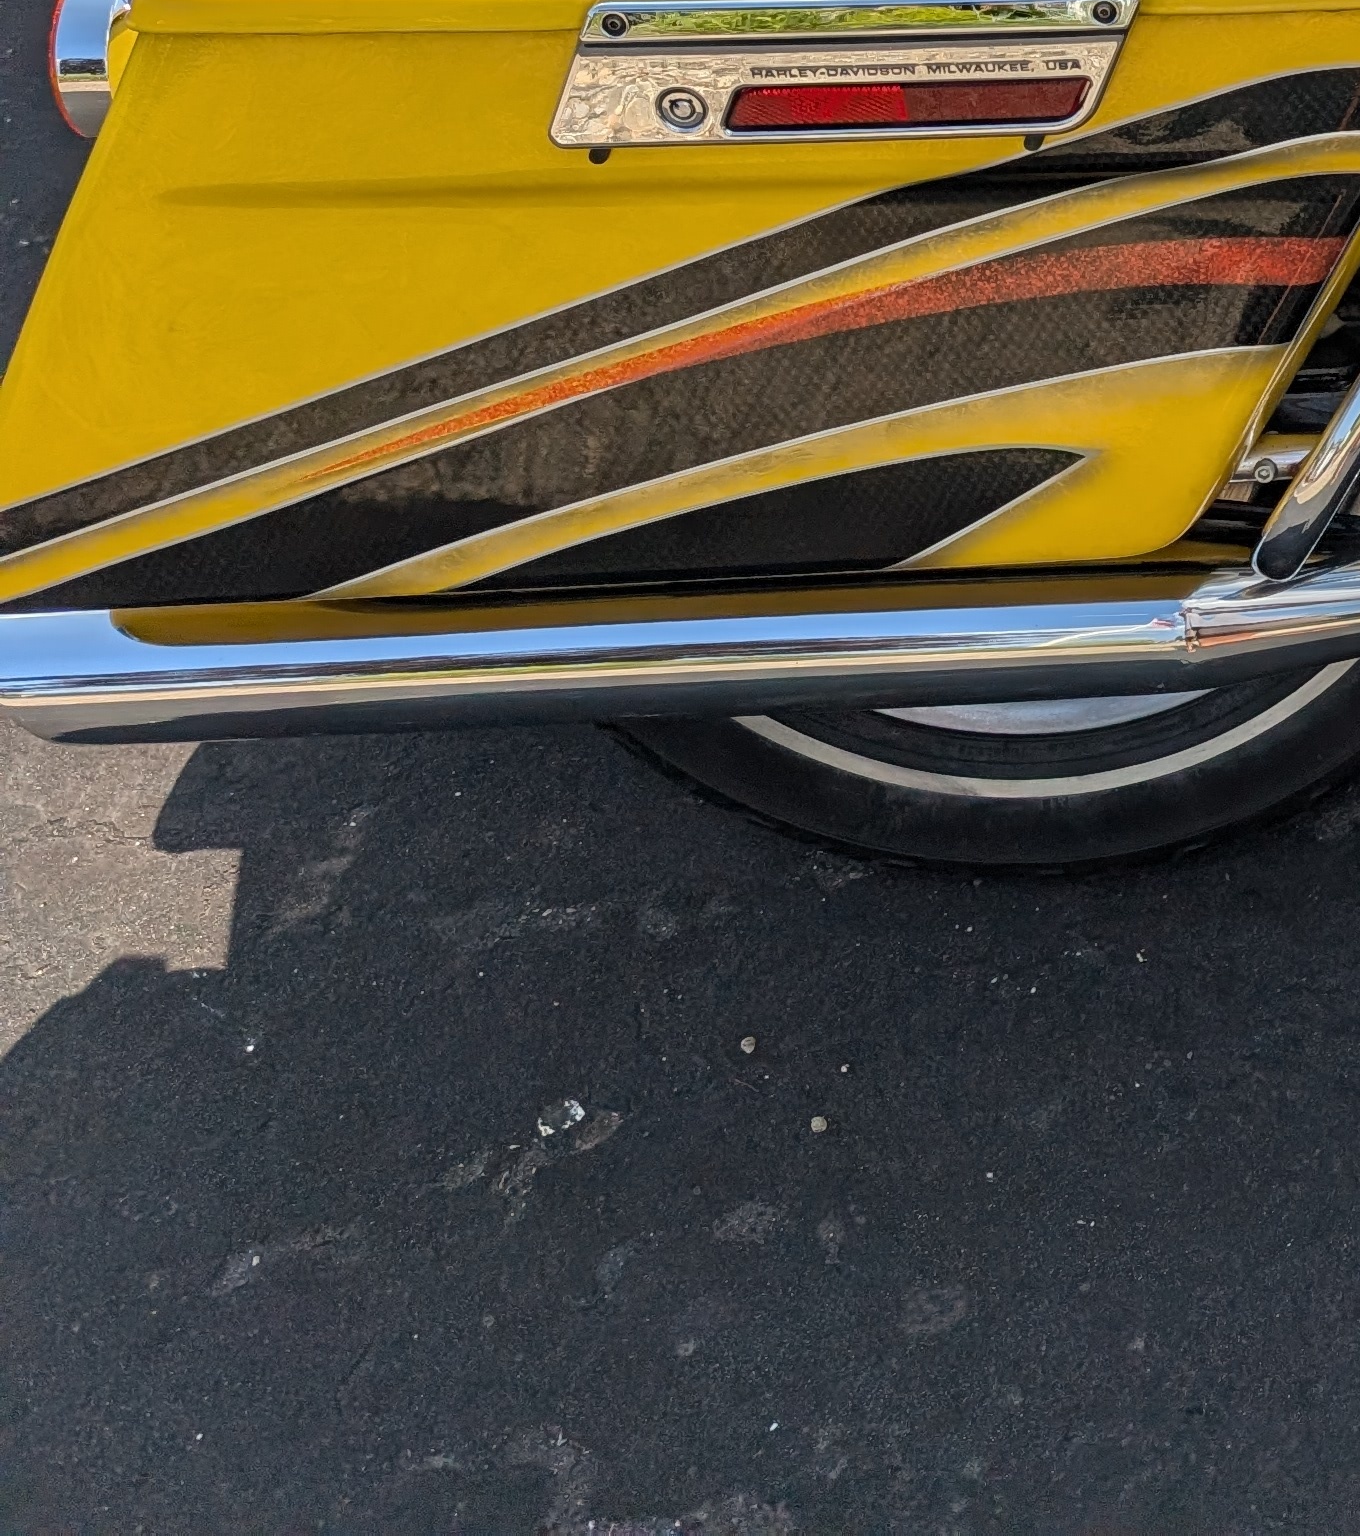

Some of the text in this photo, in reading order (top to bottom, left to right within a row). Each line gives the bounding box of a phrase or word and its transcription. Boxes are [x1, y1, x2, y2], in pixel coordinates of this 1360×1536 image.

[751, 59, 1082, 79] HARLEY-DAVIDSON MILWAUKEE, USA
